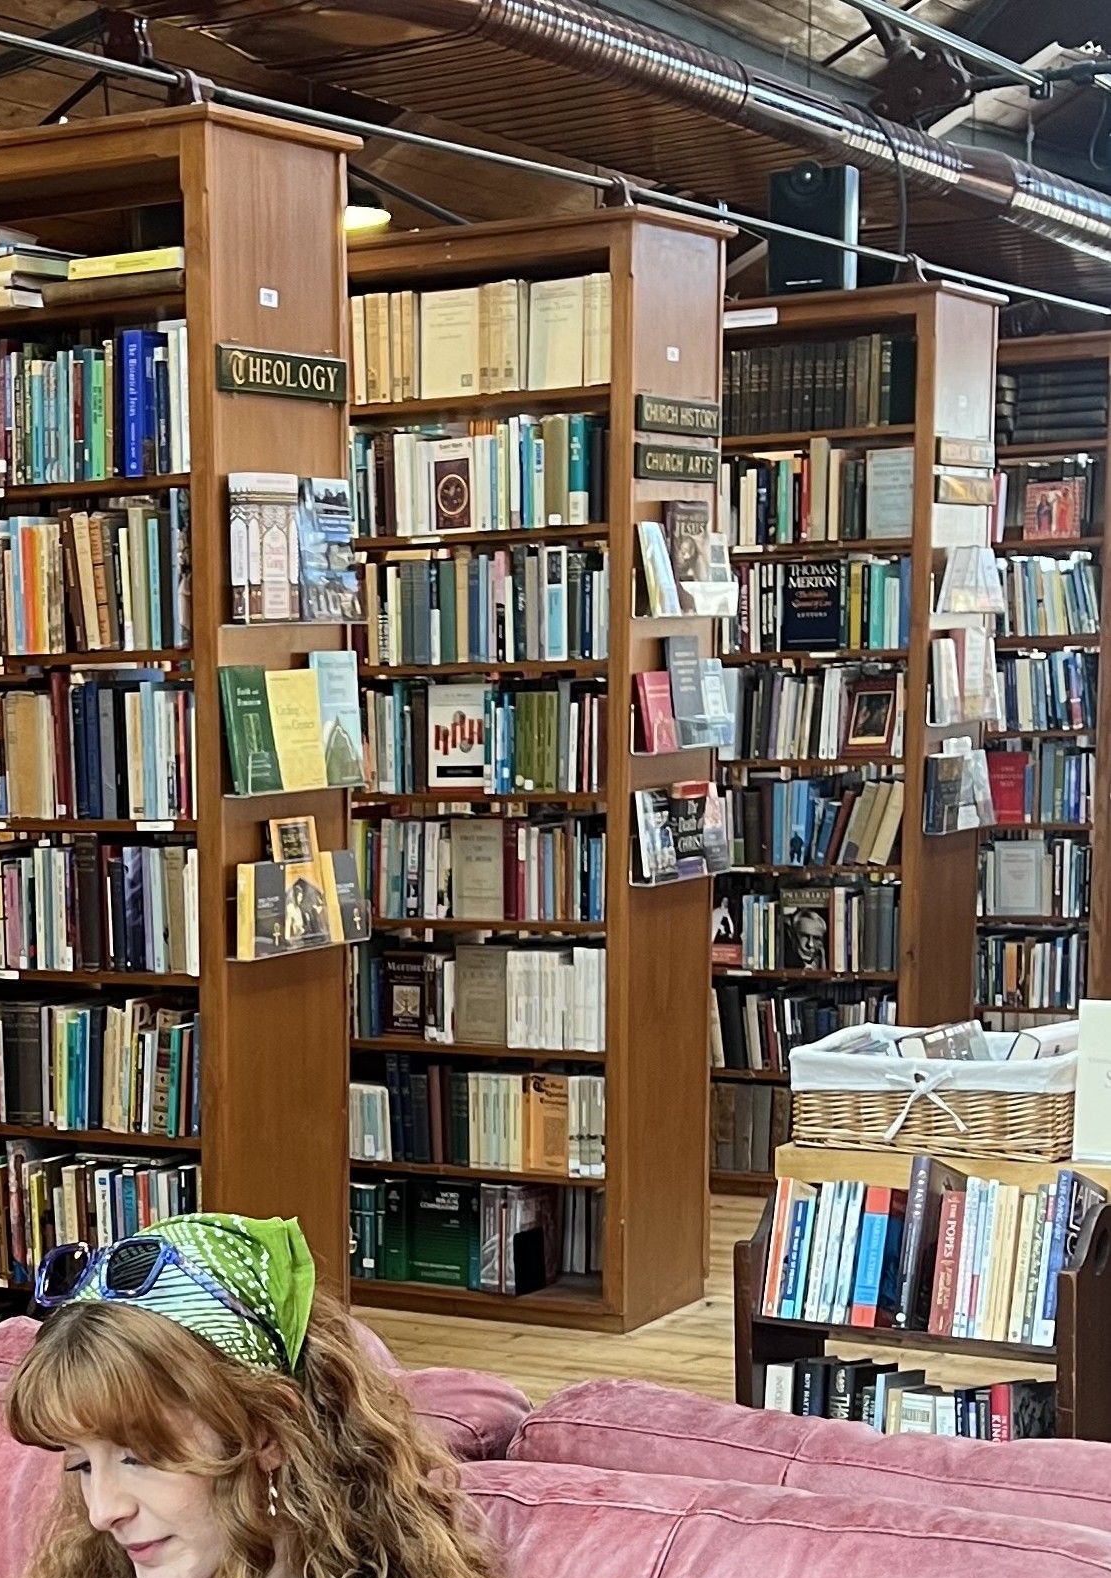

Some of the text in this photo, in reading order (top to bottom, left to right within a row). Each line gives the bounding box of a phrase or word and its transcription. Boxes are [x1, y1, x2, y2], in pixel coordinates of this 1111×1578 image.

[230, 350, 338, 393] THEOLOGY
[680, 407, 719, 429] HISTORY
[645, 452, 714, 475] CHURCH ARTS
[788, 564, 838, 577] THOMAS
[788, 575, 838, 588] MERTON
[943, 1220, 957, 1258] POPES
